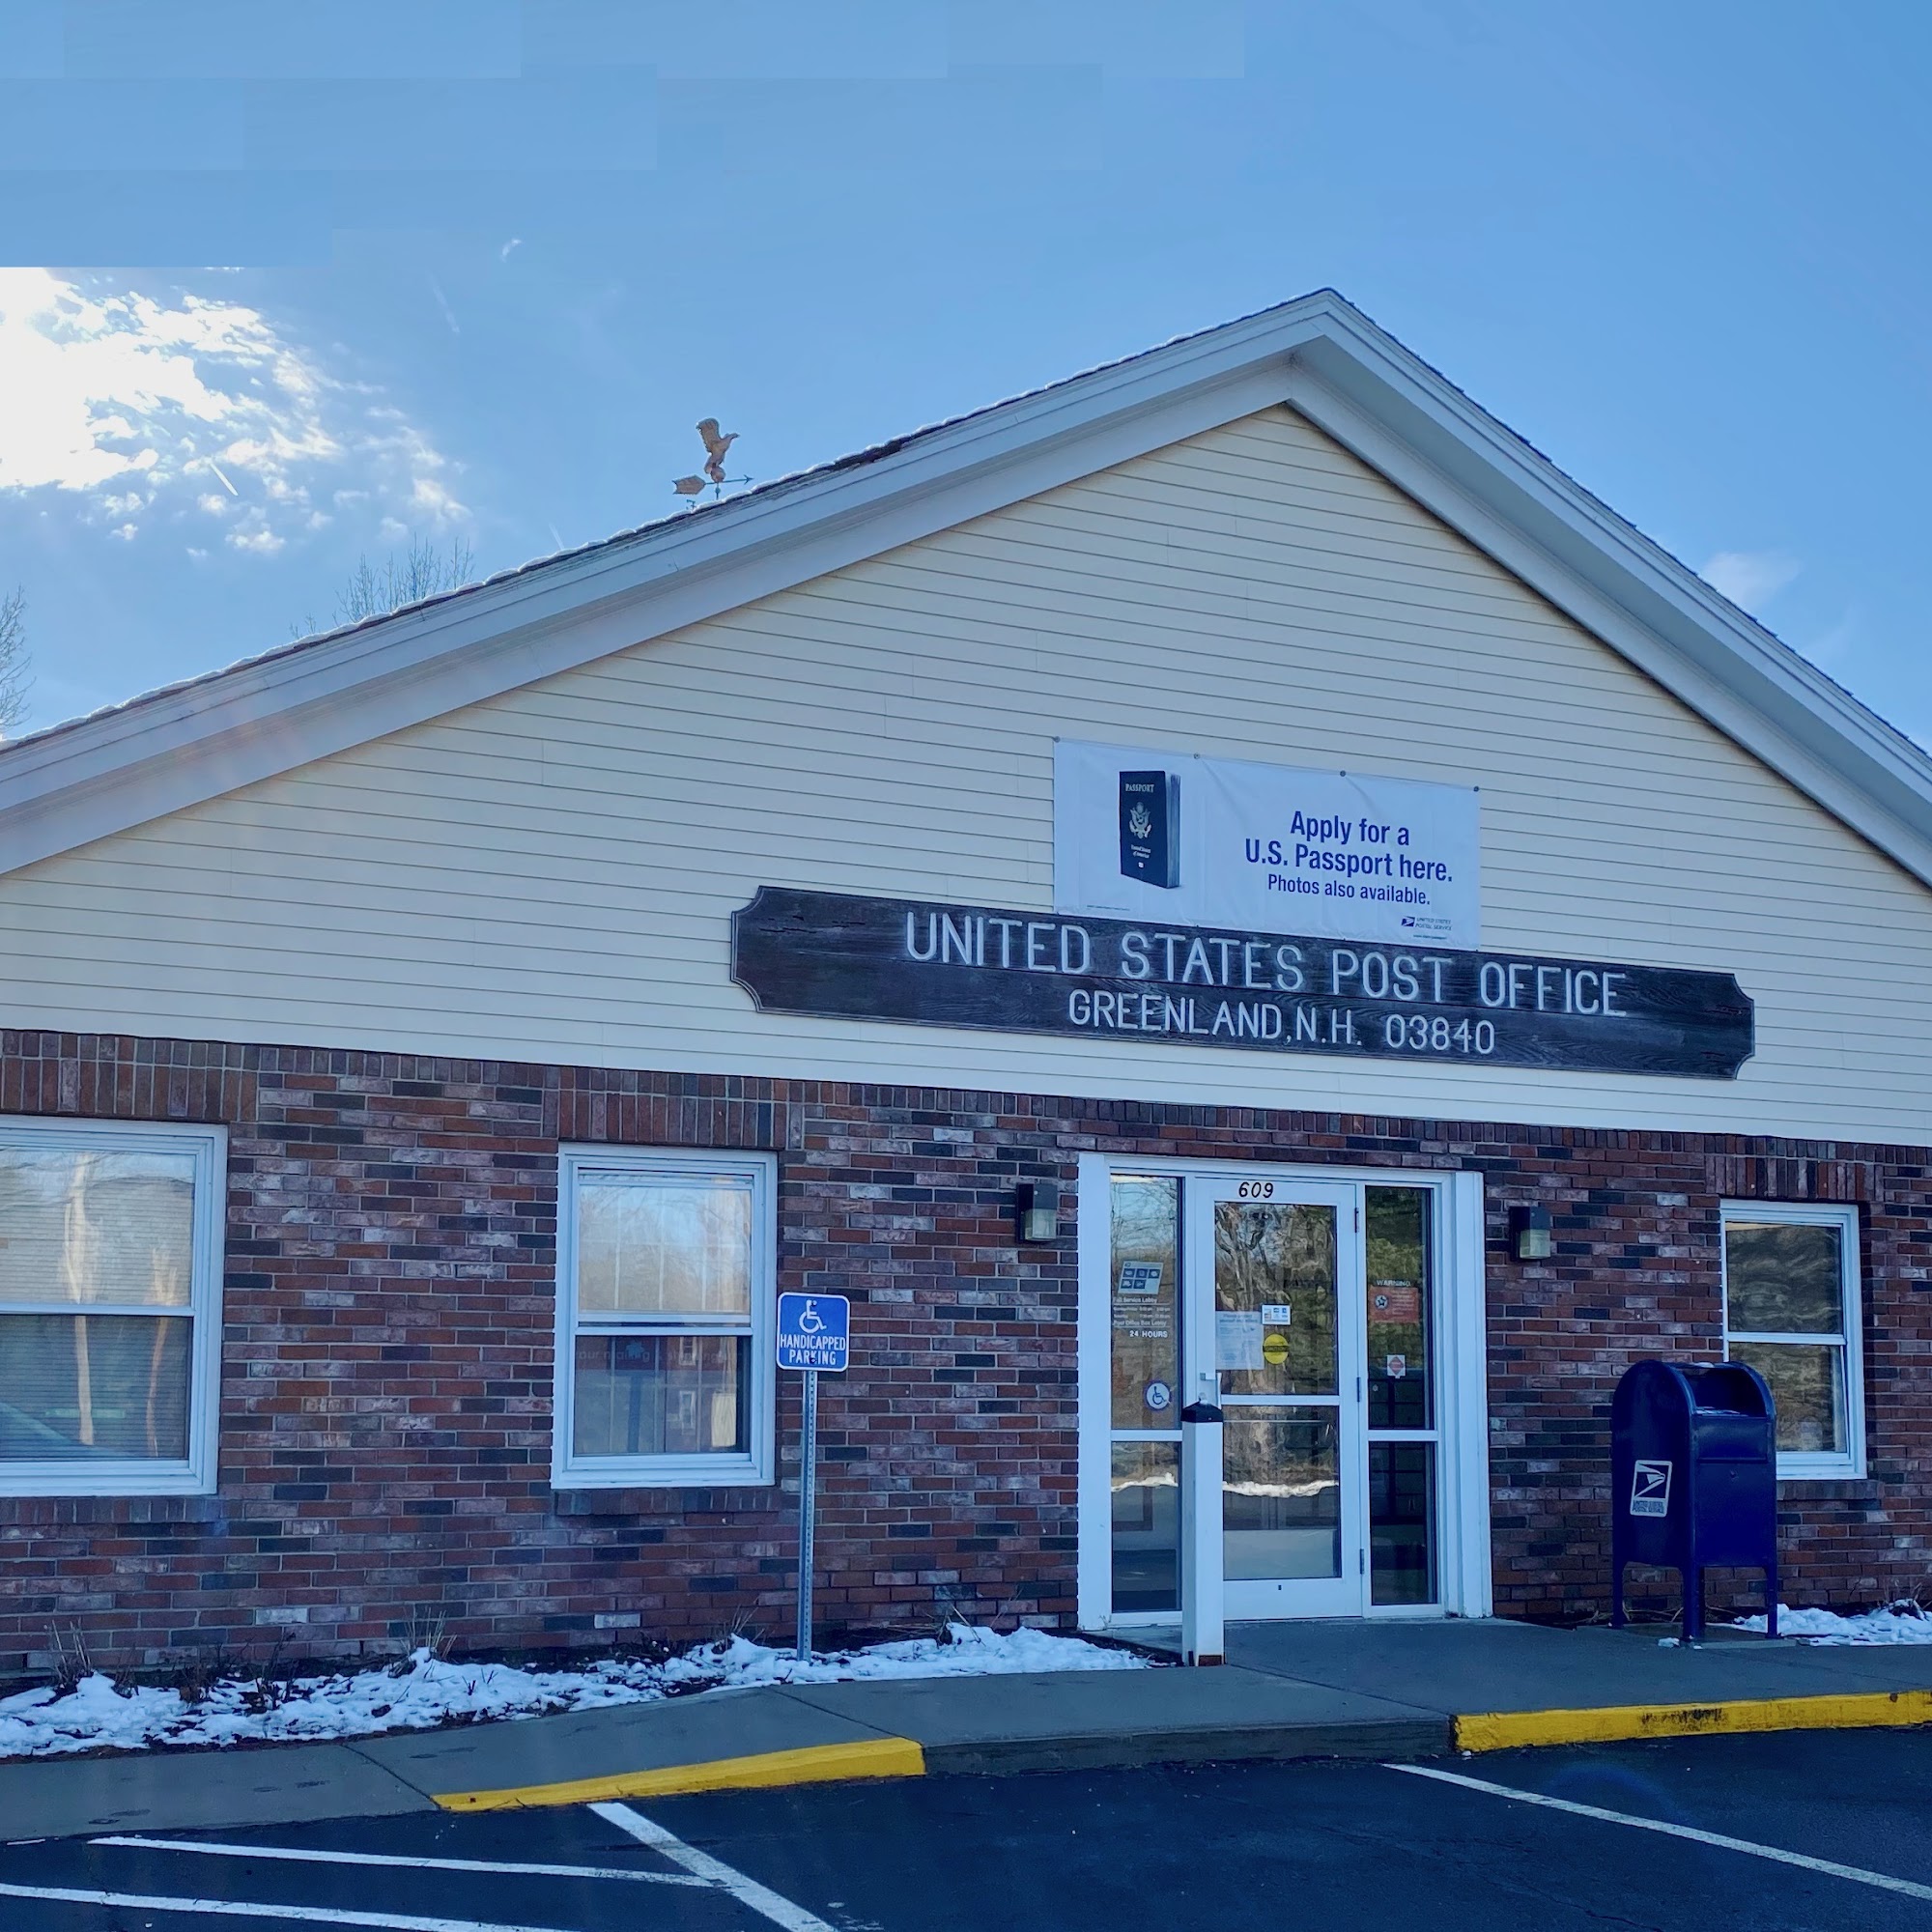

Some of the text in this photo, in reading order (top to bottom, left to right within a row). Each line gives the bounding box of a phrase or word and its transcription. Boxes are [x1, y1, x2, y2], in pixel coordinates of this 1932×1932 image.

[1125, 783, 1154, 792] PASSPORT
[1291, 810, 1409, 845] Apply for a
[1246, 838, 1452, 882] U.S. Passport here.
[1268, 873, 1431, 905] Photos also available.
[906, 911, 1627, 1016] UNITED STATES POST OFFICE
[1386, 1014, 1494, 1054] 03840
[1238, 1181, 1273, 1198] 609
[780, 1334, 846, 1350] HANDICAPPED
[1142, 1330, 1168, 1339] HOURS
[788, 1350, 837, 1365] PARKING
